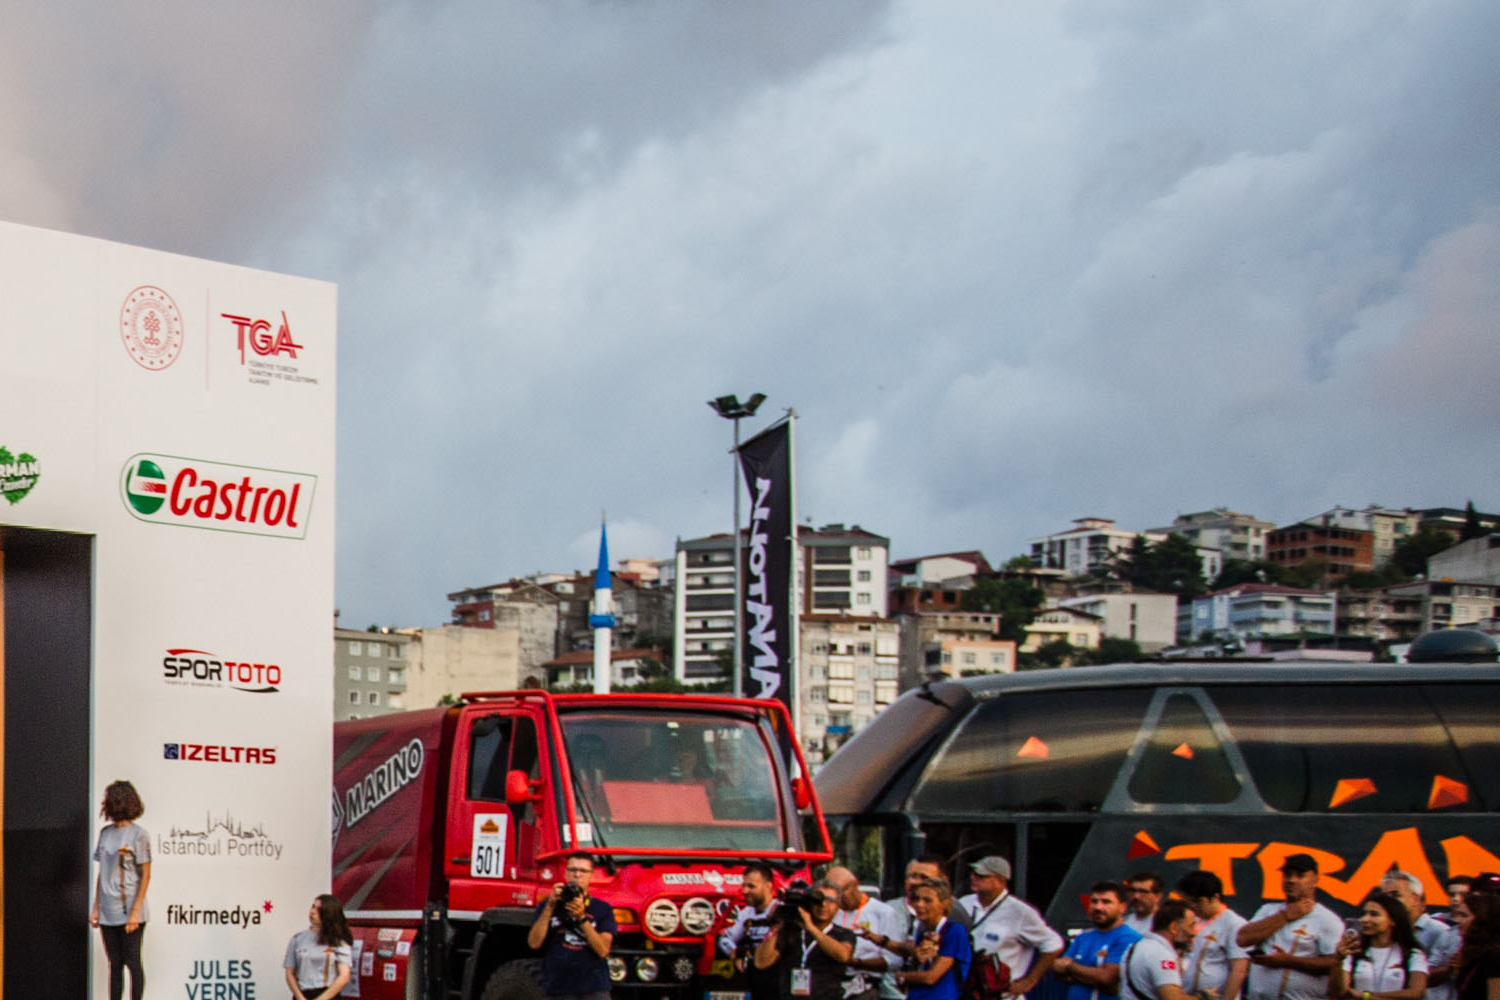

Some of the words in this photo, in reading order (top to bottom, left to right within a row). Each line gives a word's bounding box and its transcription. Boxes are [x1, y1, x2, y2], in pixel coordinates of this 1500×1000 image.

[221, 310, 304, 365] TGA
[169, 468, 301, 528] Castrol
[180, 744, 276, 764] IZELTAS
[346, 738, 424, 828] MARINO
[476, 846, 501, 876] 501
[167, 904, 261, 929] fikirmedya
[188, 960, 253, 980] JULES
